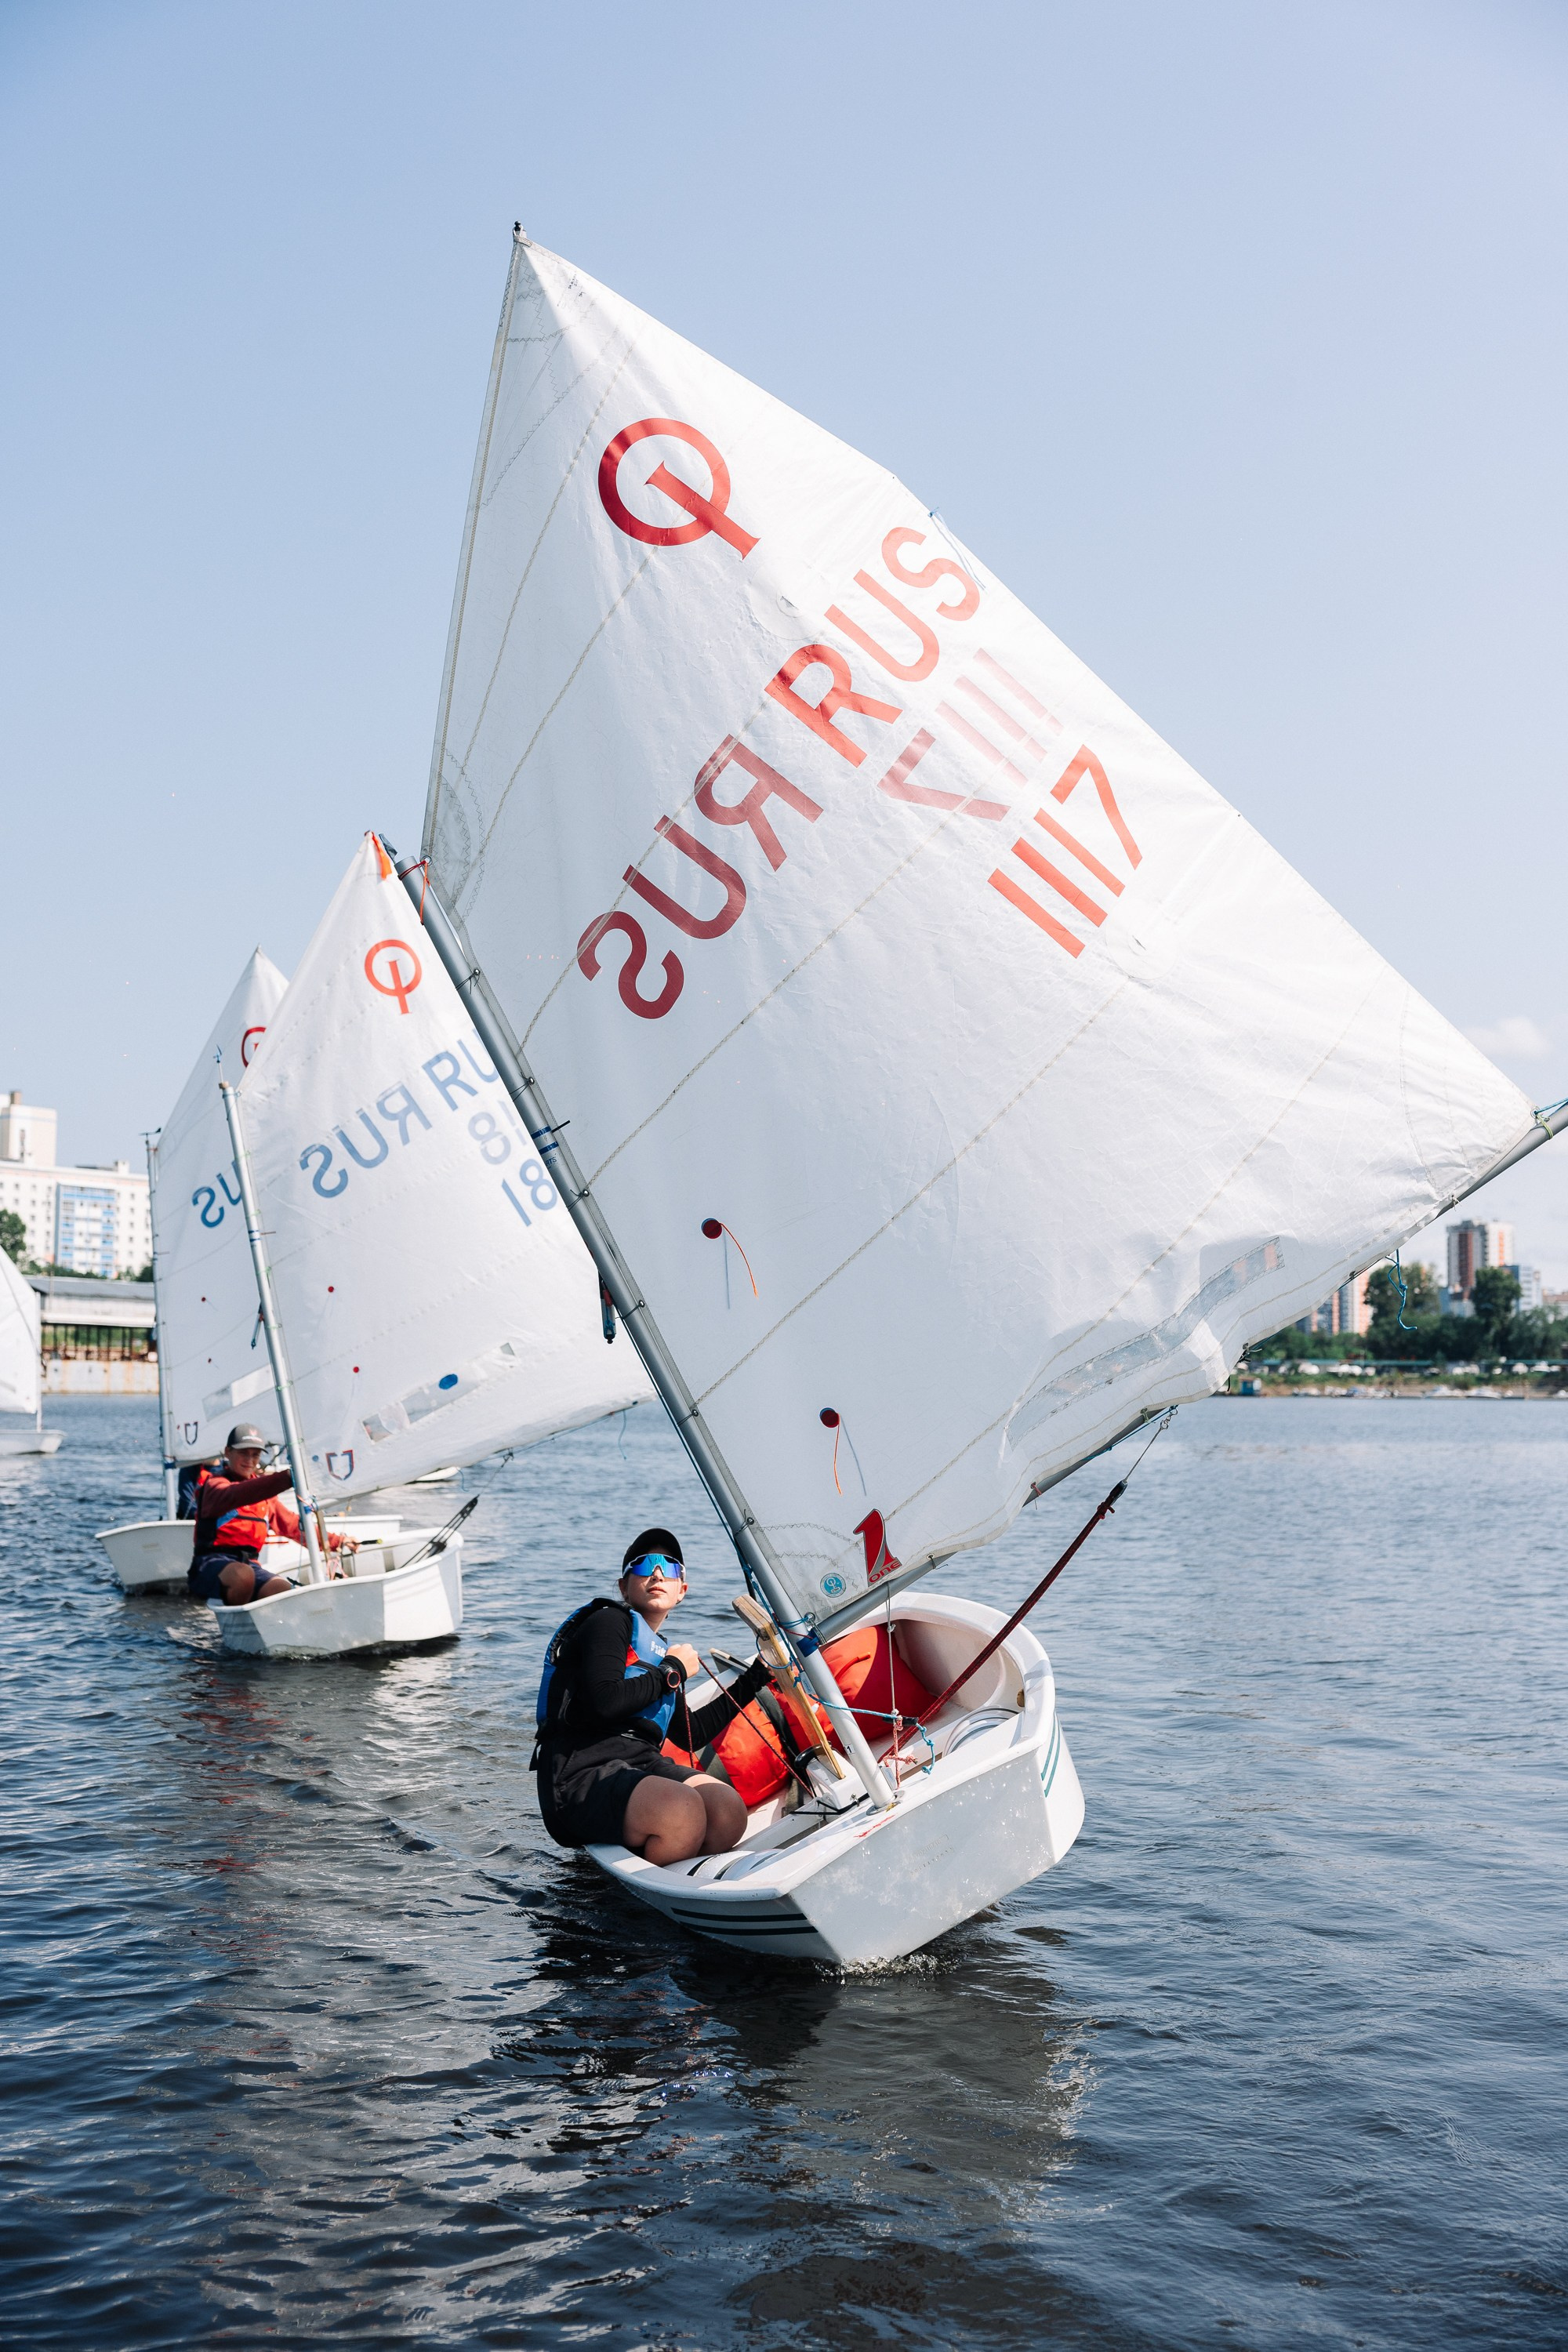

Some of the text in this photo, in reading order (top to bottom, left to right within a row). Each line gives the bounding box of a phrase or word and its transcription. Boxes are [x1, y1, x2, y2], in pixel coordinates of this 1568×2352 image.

[764, 526, 981, 768] RUS
[986, 744, 1143, 959] 1117
[422, 1029, 500, 1112] RU
